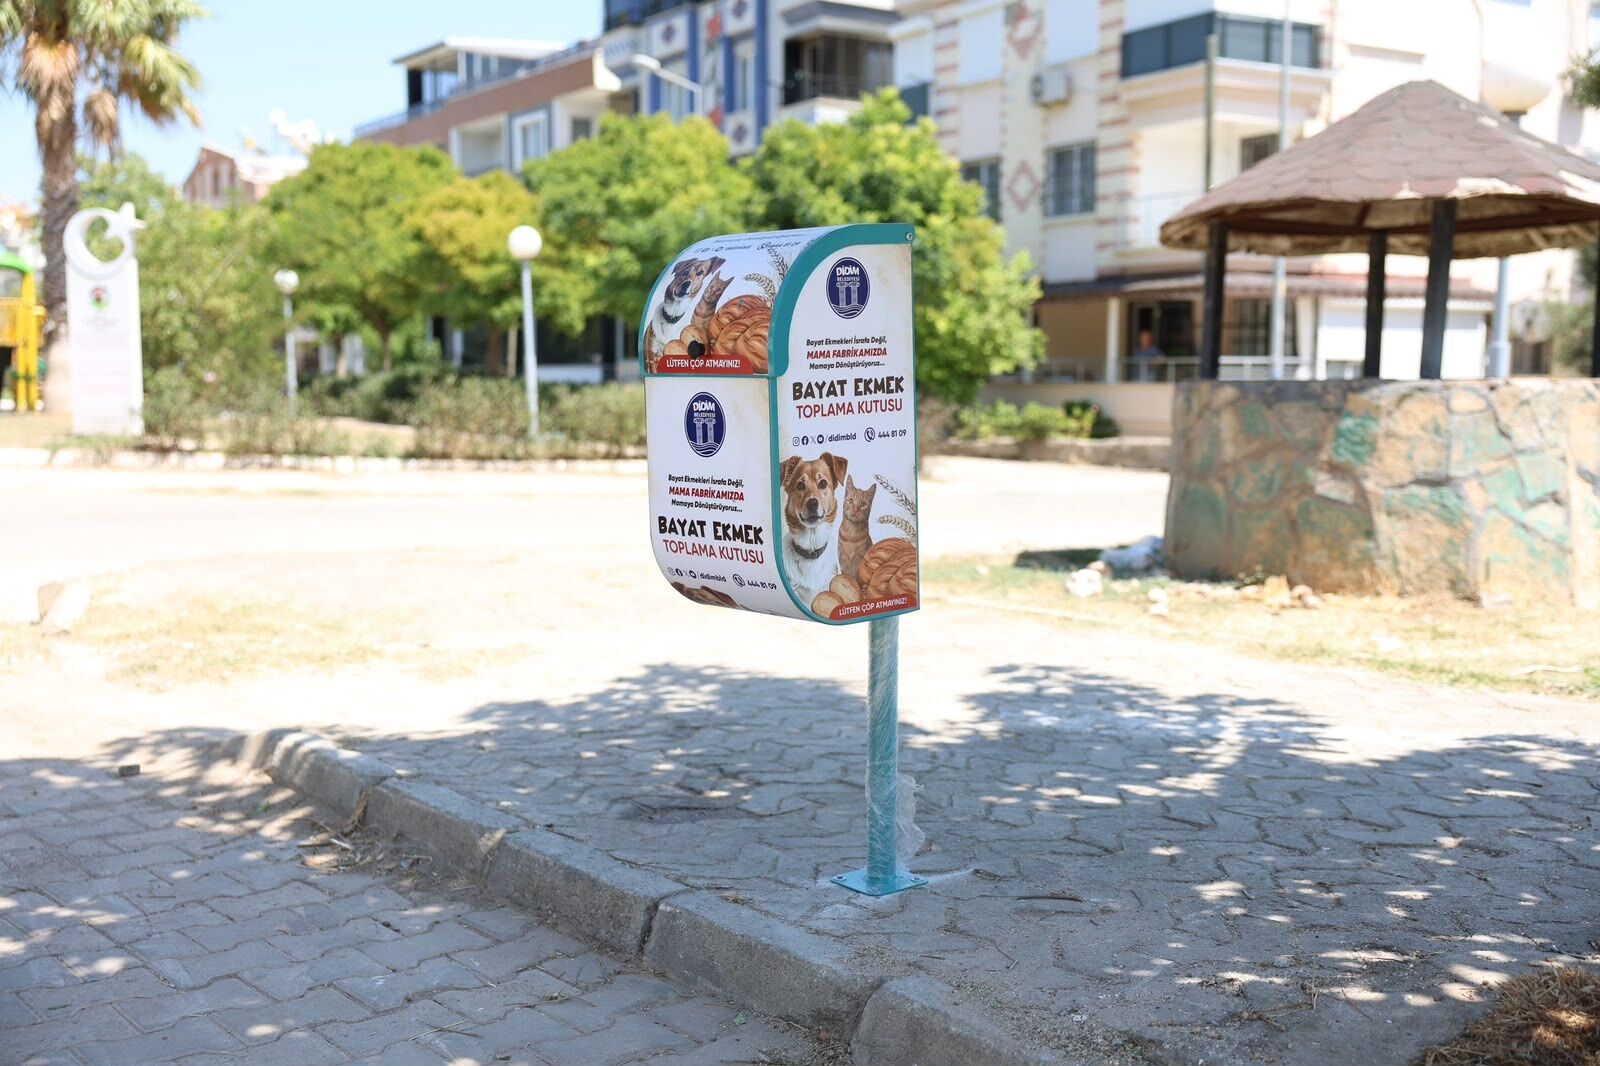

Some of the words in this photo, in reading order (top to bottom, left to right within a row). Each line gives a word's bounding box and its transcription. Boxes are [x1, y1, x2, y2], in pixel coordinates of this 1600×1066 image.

[806, 339, 824, 347] Bayat
[825, 337, 853, 346] Ekmekleri
[854, 335, 870, 344] İsrafa
[871, 336, 887, 345] Değil,
[806, 350, 831, 360] MAMA
[832, 347, 887, 358] FABRİKAMIZDA
[666, 357, 689, 368] LÜTFEN
[705, 359, 741, 368] ATMAYINIZ!
[809, 362, 834, 371] Mamaya
[835, 360, 886, 369] Dönüştürüyoruz...
[792, 379, 847, 401] BAYAT
[854, 376, 904, 396] EKMEK
[796, 401, 854, 419] TOPLAMA
[858, 398, 903, 414] KUTUSU
[878, 430, 890, 438] 444
[891, 429, 898, 438] 81
[898, 429, 907, 437] 09
[668, 474, 684, 483] Bayat
[684, 475, 710, 484] Ekmekleri
[710, 475, 727, 485] İsrafa
[727, 478, 745, 488] Değil,
[668, 486, 690, 496] MAMA
[691, 487, 744, 501] FABRİKAMIZDA
[671, 499, 694, 508] Mamaya
[658, 516, 707, 538] BAYAT
[713, 521, 764, 545] EKMEK
[662, 539, 717, 559] TOPLAMA
[719, 546, 765, 564] KUTUSU
[839, 605, 861, 616] LÜTFEN
[861, 603, 874, 612] ÇÖP
[875, 597, 907, 609] ATMAYINIZ!
